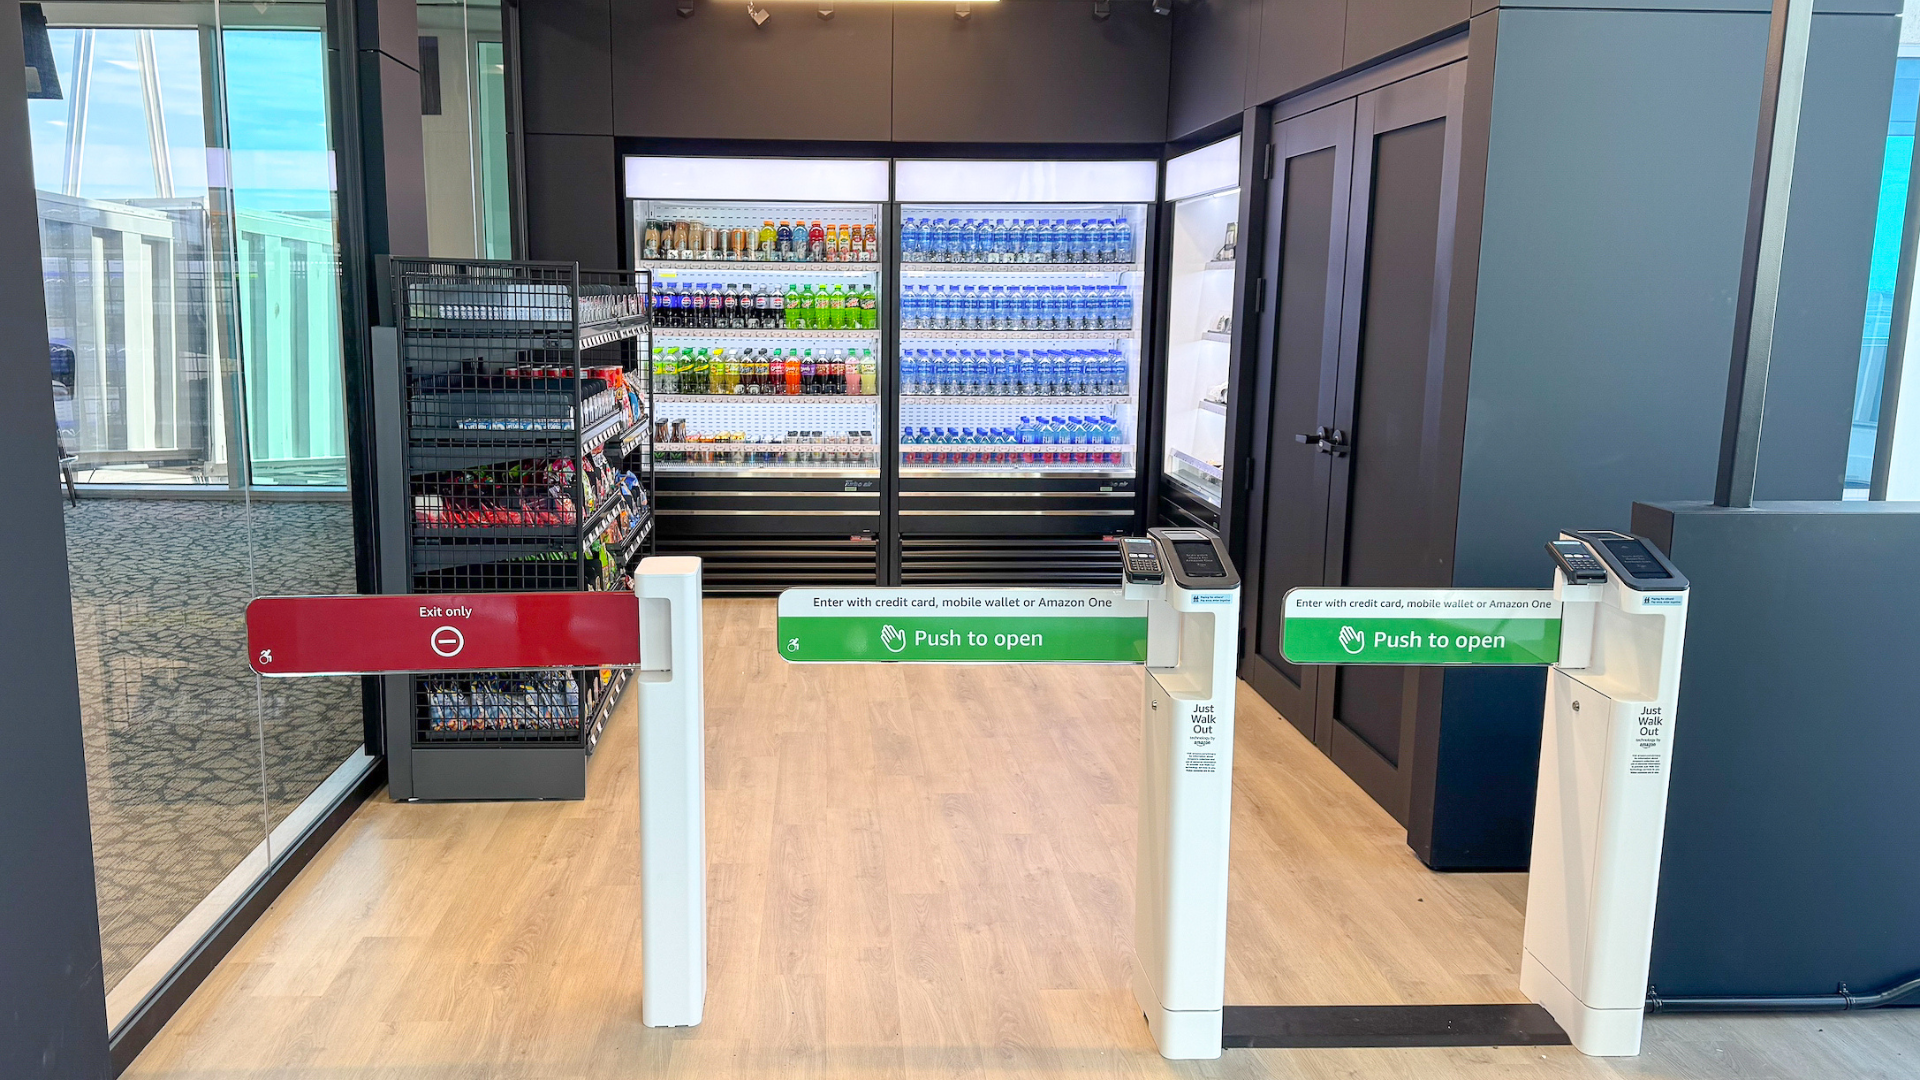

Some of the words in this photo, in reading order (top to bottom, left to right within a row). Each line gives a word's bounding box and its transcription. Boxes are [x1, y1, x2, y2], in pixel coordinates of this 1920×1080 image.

[813, 597, 843, 608] Enter
[847, 597, 872, 608] with
[875, 597, 908, 608] credit
[912, 597, 939, 609] card,
[943, 597, 982, 608] mobile
[985, 597, 1020, 608] wallet
[1023, 599, 1036, 608] or
[1039, 597, 1085, 608] Amazon
[1088, 597, 1113, 608] One
[1296, 599, 1323, 608] Enter
[1325, 598, 1347, 608] with
[1350, 599, 1378, 608] credit
[1380, 599, 1404, 609] card,
[1407, 599, 1441, 608] mobile
[1444, 599, 1474, 608] wallet
[1489, 599, 1529, 608] Amazon
[1531, 599, 1552, 608] One
[419, 606, 442, 618] Exit
[446, 606, 472, 619] only
[915, 629, 960, 647] Push
[967, 631, 988, 647] to
[994, 633, 1043, 649] open
[1373, 630, 1422, 648] Push
[1428, 632, 1449, 648] to
[1455, 634, 1506, 652] open
[1193, 704, 1215, 713] Just
[1640, 706, 1662, 716] Just
[1191, 714, 1217, 724] Walk
[1638, 716, 1663, 726] Walk
[1193, 724, 1213, 734] Out
[1639, 726, 1659, 736] Out
